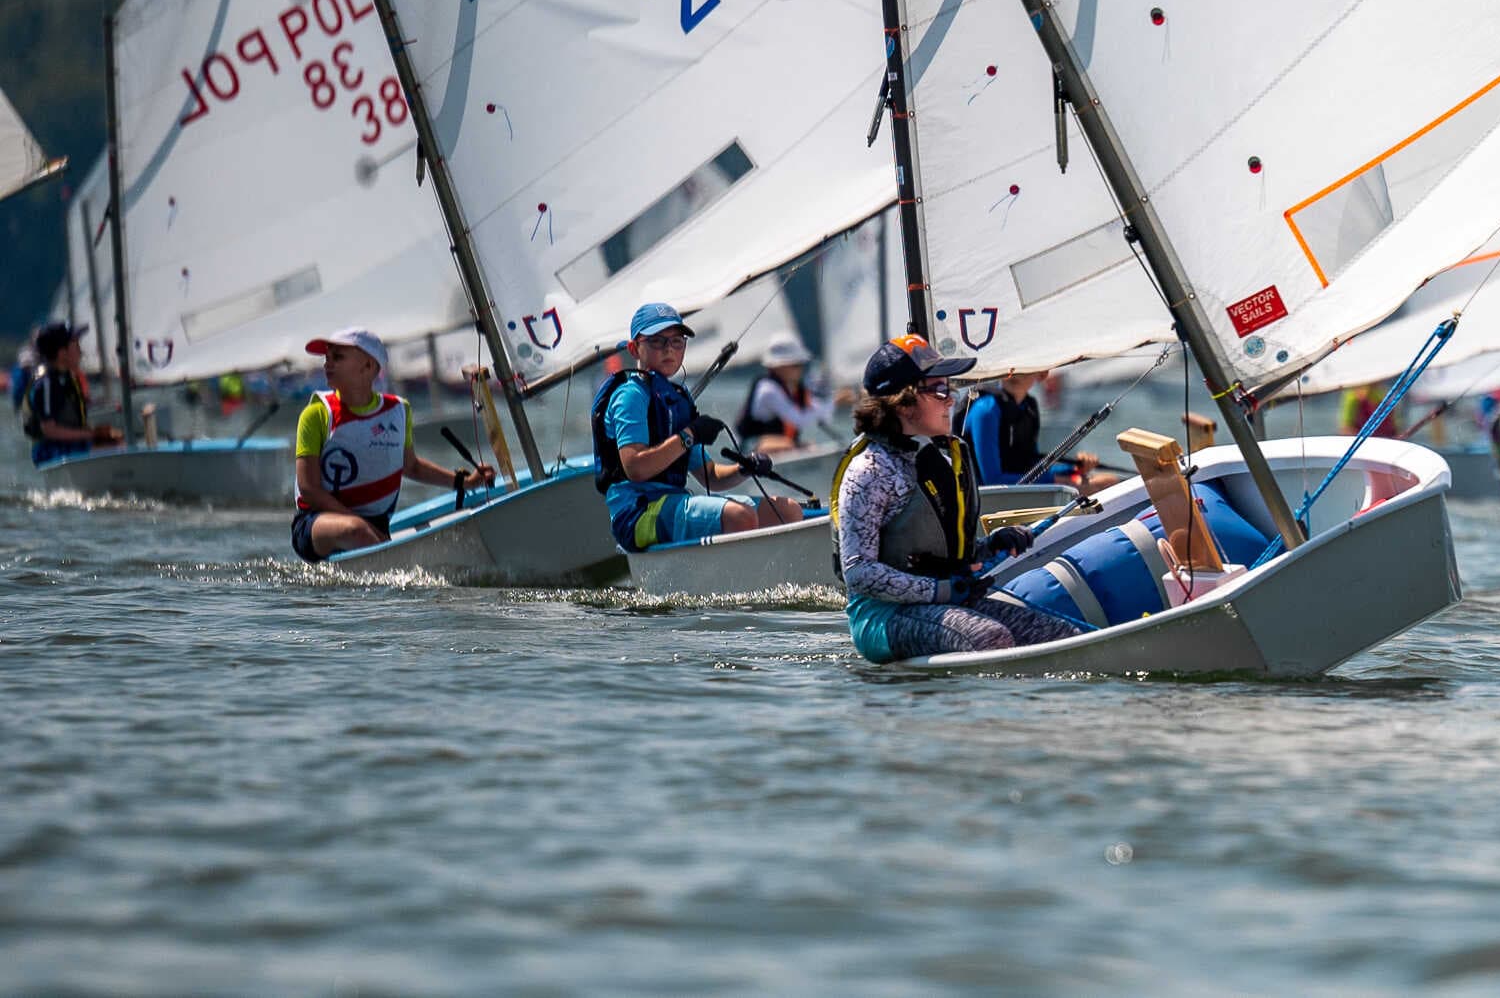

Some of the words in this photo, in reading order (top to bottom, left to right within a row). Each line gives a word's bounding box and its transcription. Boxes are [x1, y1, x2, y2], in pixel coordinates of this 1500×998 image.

[352, 77, 408, 146] 38
[1230, 290, 1275, 318] VECTOR
[1240, 302, 1273, 324] SAILS
